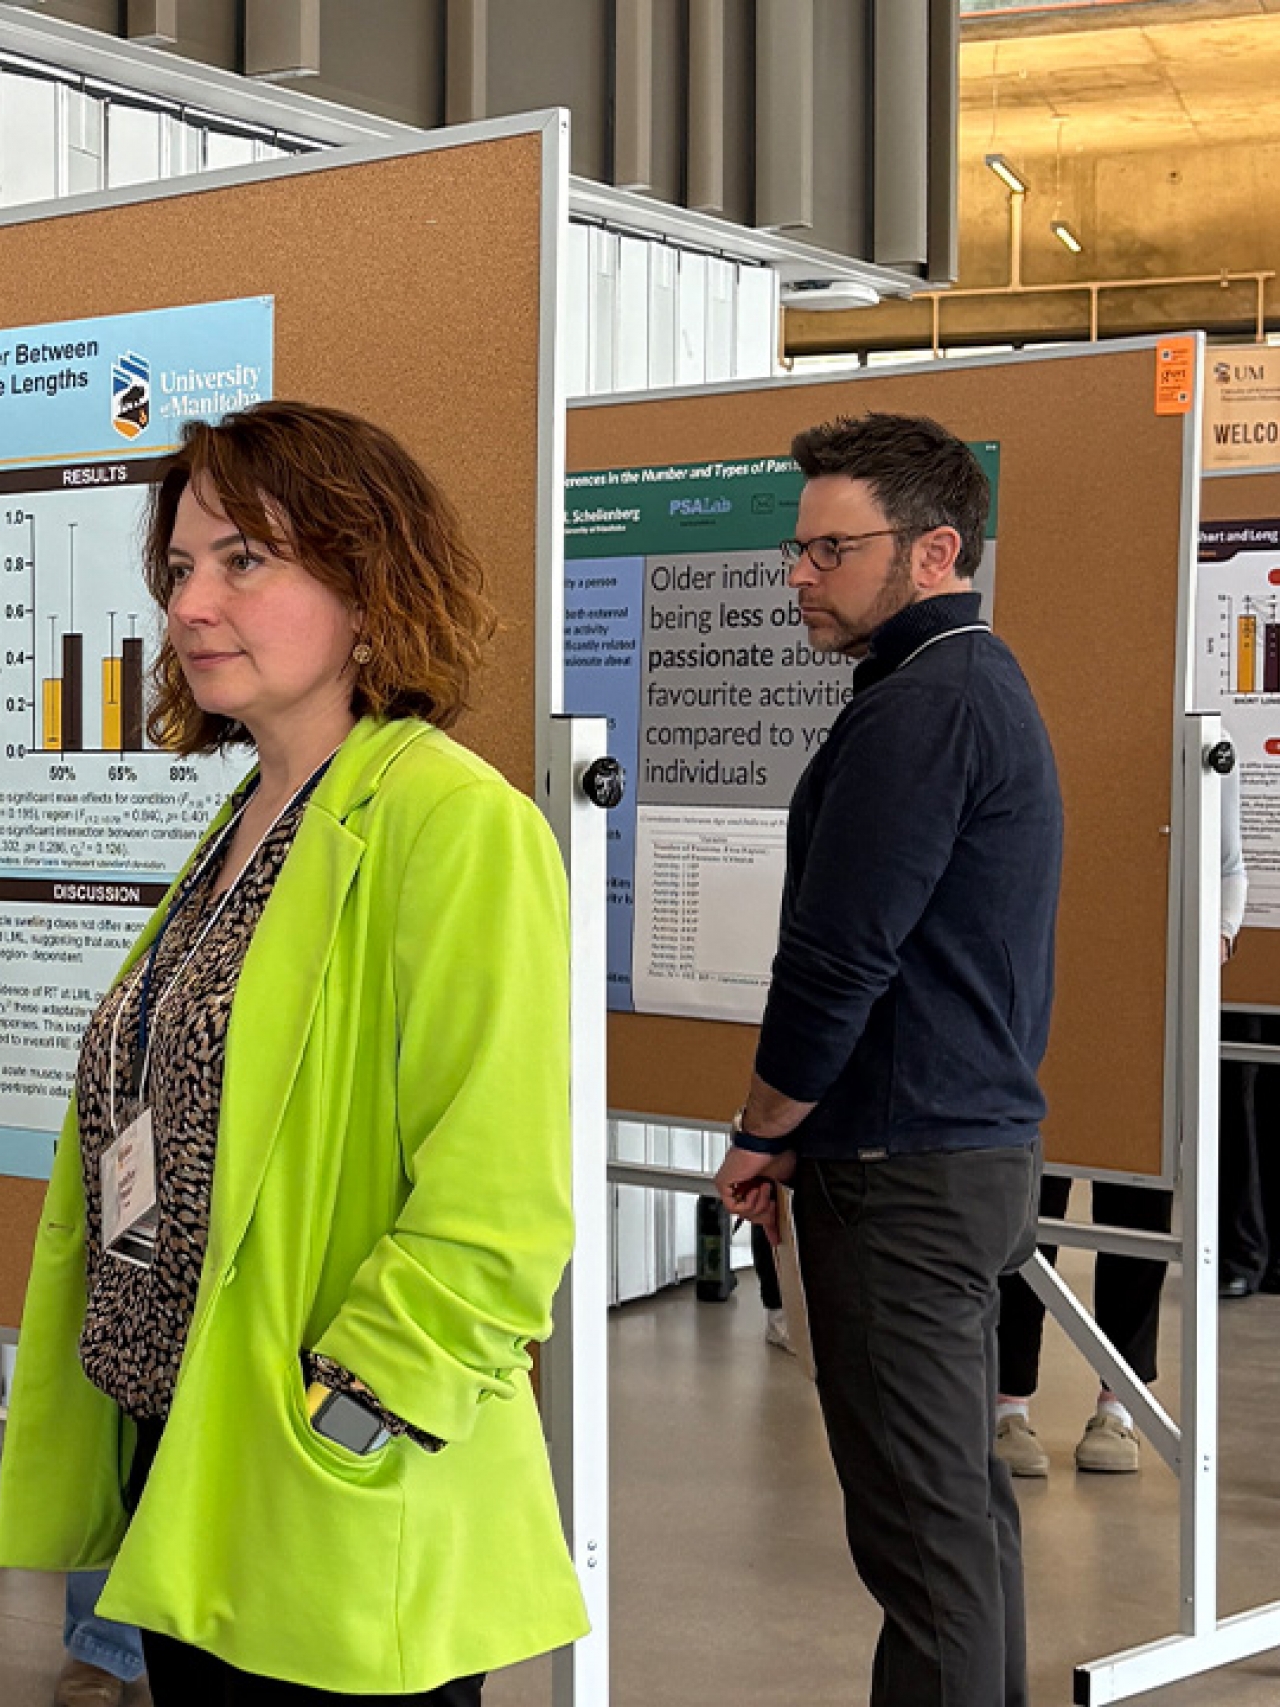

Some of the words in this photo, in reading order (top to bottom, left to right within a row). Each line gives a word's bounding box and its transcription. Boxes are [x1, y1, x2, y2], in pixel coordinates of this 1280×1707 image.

[15, 339, 98, 365] Between
[159, 363, 261, 394] University
[1235, 364, 1264, 381] UM
[11, 367, 88, 399] Lengths
[1213, 421, 1279, 445] WELCO
[63, 465, 127, 485] RESULTS
[642, 468, 688, 482] Number
[689, 464, 712, 478] and
[715, 464, 748, 481] Types
[5, 510, 25, 525] 1.0
[4, 557, 25, 572] 0.8
[651, 565, 716, 591] Older
[722, 561, 794, 590] indivi
[5, 604, 25, 619] 0.6
[650, 604, 711, 635] being
[719, 603, 764, 628] less
[5, 651, 25, 666] 0.4
[648, 642, 773, 673] passionate
[646, 681, 752, 708] favourite
[758, 680, 855, 707] activitie
[5, 698, 25, 712] 0.2
[645, 720, 762, 750] compared
[770, 725, 795, 747] to
[6, 744, 26, 758] 0.0
[48, 766, 76, 782] 50%
[645, 758, 768, 786] individuals
[54, 883, 140, 901] DISCUSSION
